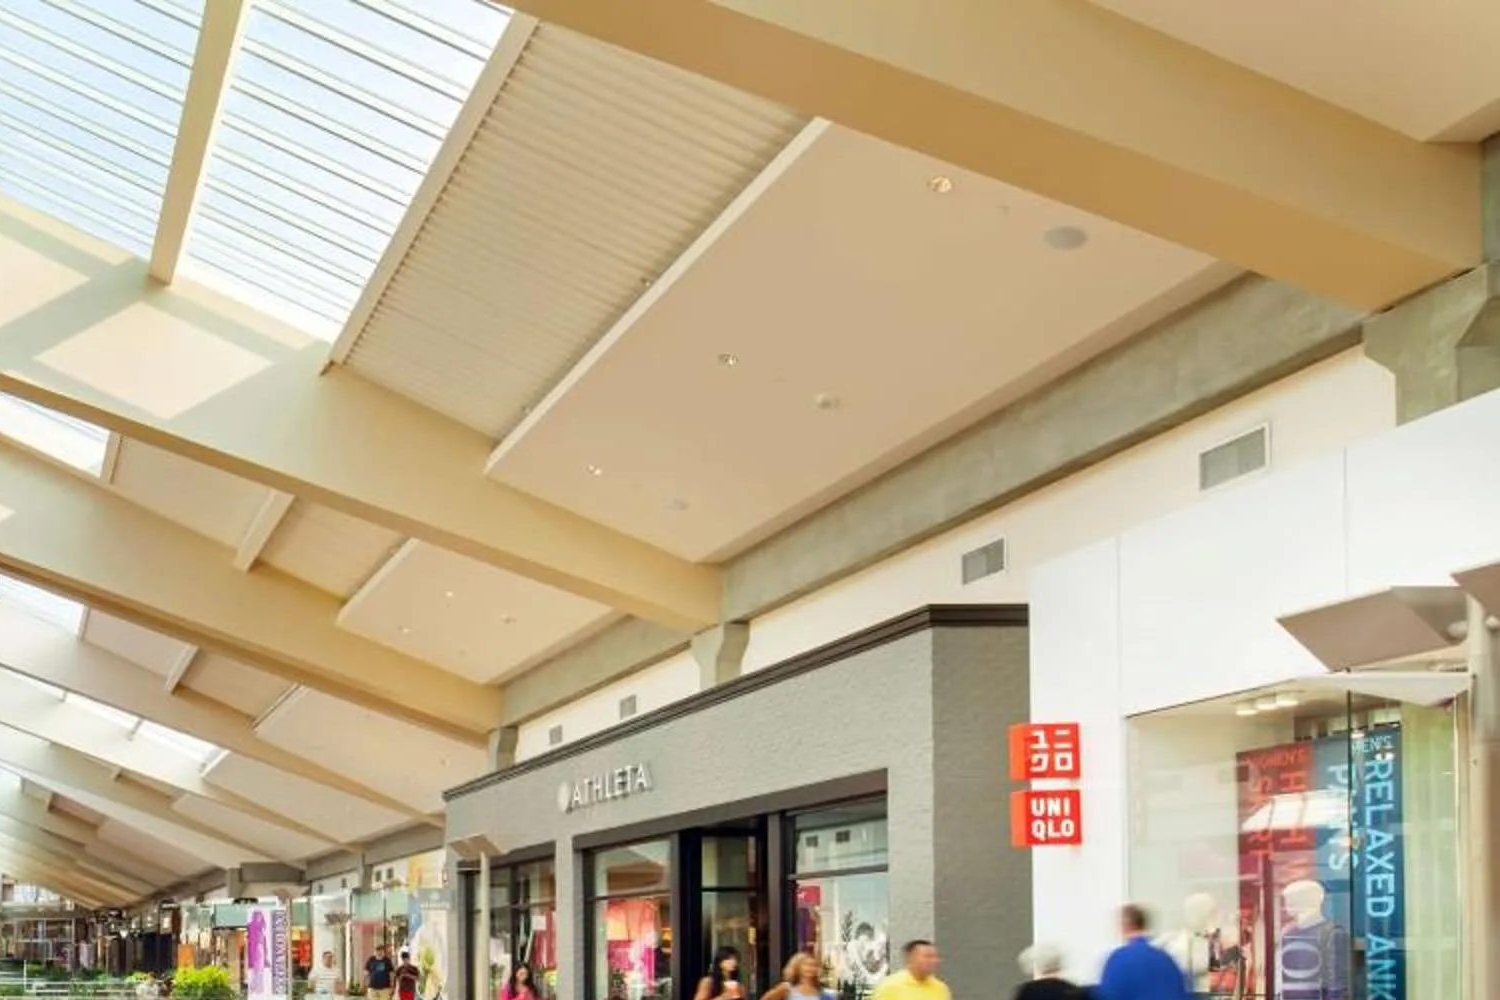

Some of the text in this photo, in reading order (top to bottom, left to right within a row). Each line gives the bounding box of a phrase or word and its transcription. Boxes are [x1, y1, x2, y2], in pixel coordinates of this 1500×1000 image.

[571, 762, 648, 806] ATHLETA
[1031, 797, 1071, 817] UNI
[1031, 819, 1075, 841] QLO
[1364, 760, 1395, 917] RELAXED
